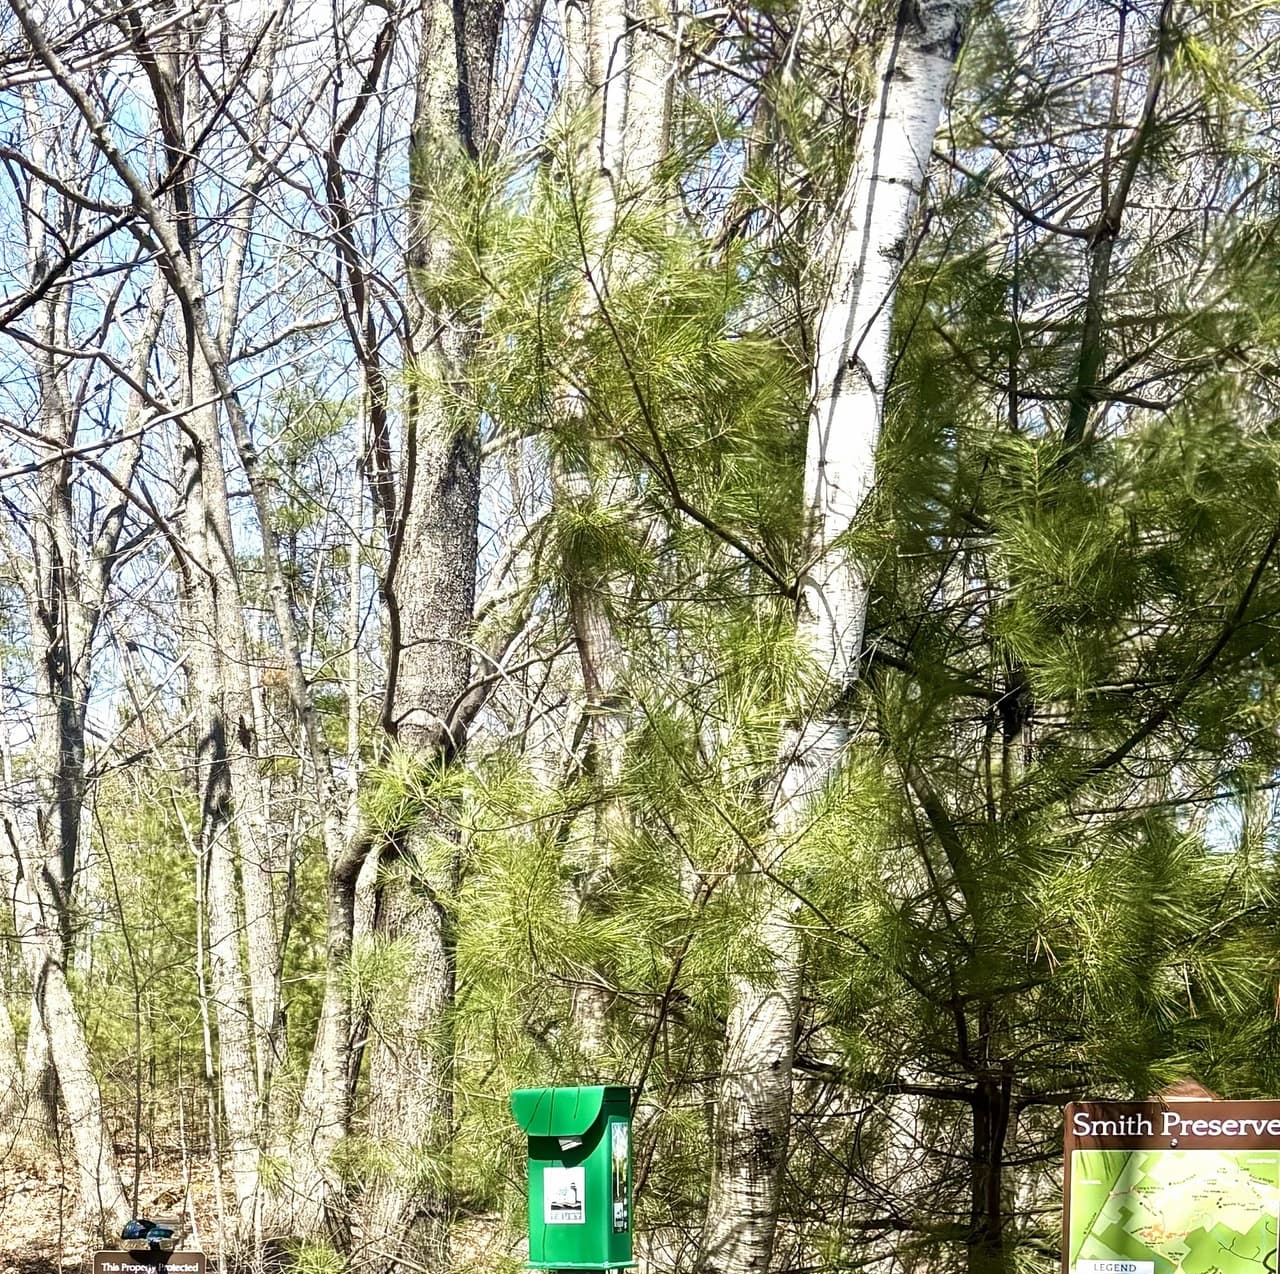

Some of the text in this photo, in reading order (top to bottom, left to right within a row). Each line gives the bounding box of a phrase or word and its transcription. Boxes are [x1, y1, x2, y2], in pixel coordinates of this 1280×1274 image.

[1073, 1112, 1280, 1136] Smith Preserve
[101, 1262, 119, 1271] This
[1094, 1263, 1136, 1272] LEGEND
